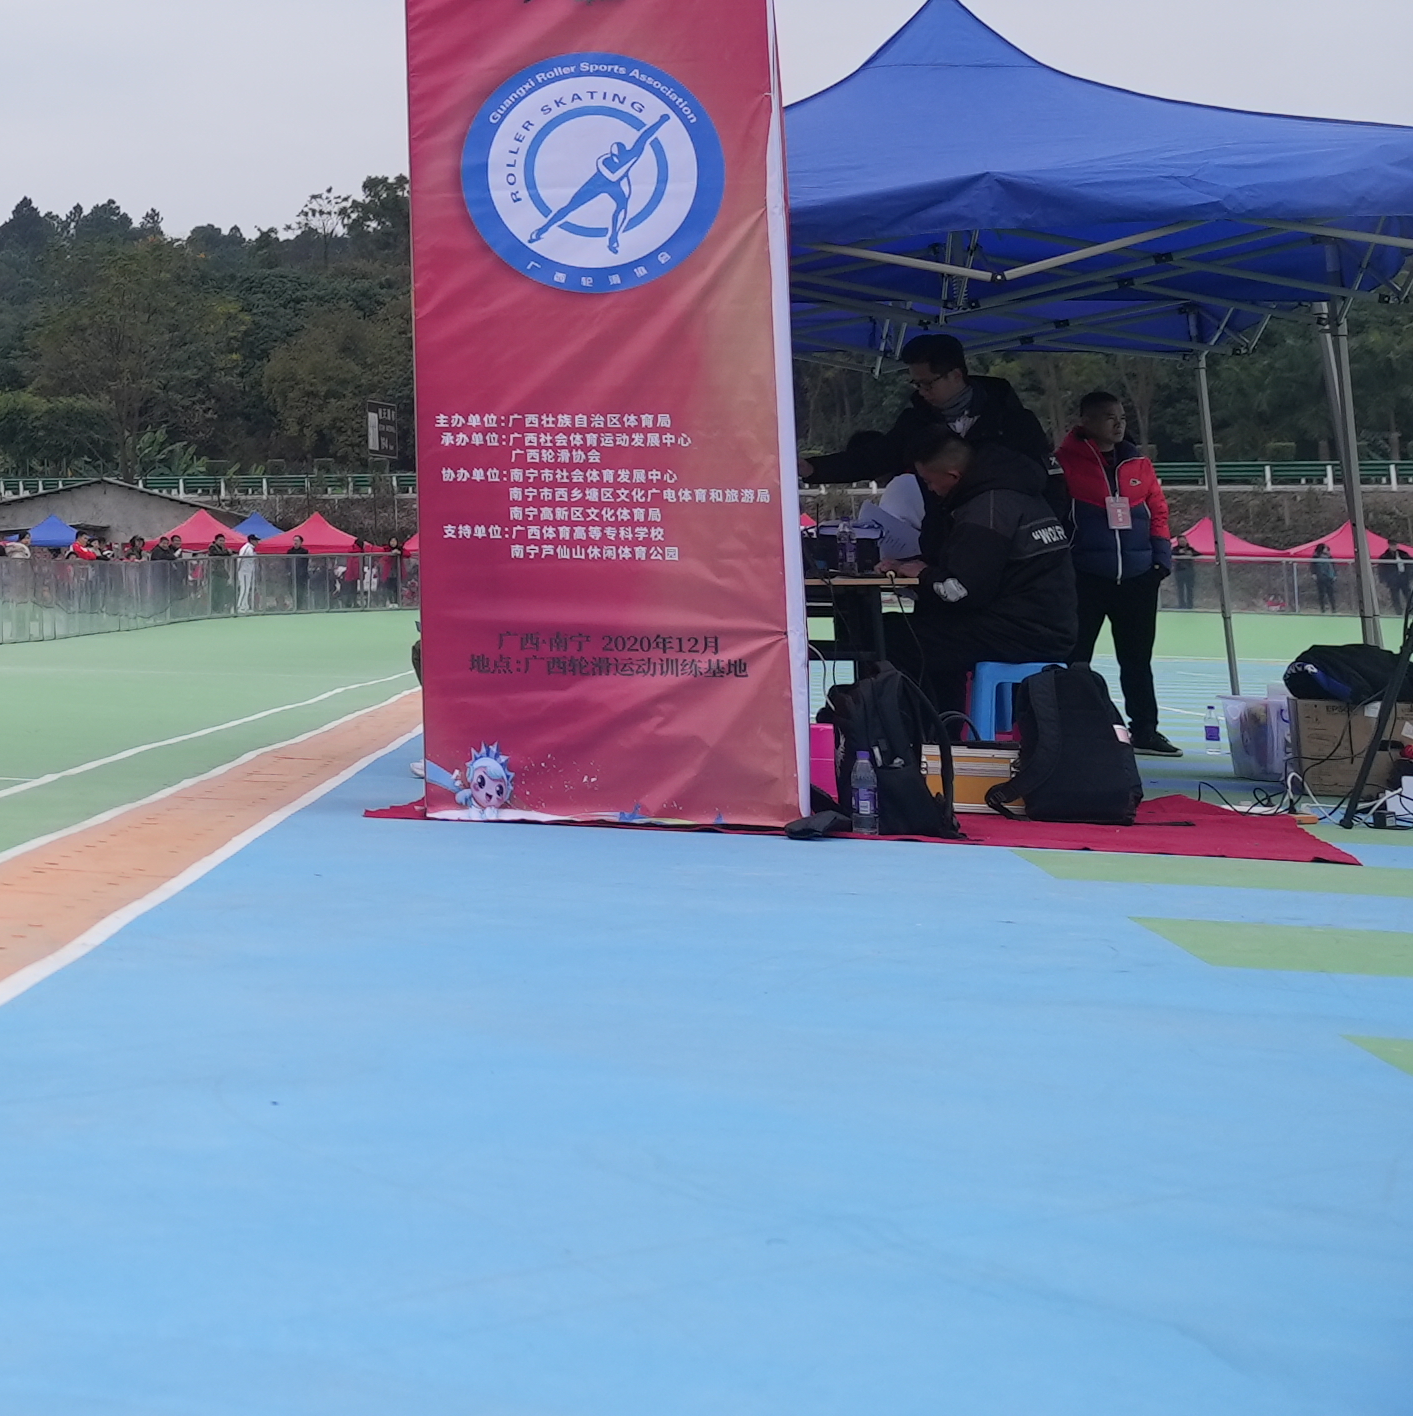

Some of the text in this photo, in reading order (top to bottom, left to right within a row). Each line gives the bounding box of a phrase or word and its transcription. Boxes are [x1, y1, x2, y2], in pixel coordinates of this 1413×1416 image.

[488, 62, 698, 125] Guangxi Roller Sports Association
[506, 90, 646, 203] ROLLER SKATING
[434, 413, 672, 429] 主办单位:广西壮族自治区体育局
[440, 432, 692, 448] 承办单位:广西社会体育运动发展中心
[510, 448, 601, 464] 广西轮滑协会
[509, 507, 662, 522] 南宁高新区文化体育局
[442, 524, 665, 541] 支持单位:广西体育高等专科学校
[510, 545, 680, 561] 南宁芦仙山休闲体育公园
[497, 630, 721, 656] 广西·南宁 2020年12月
[469, 653, 750, 679] 地点:广西轮滑运动训练基地
